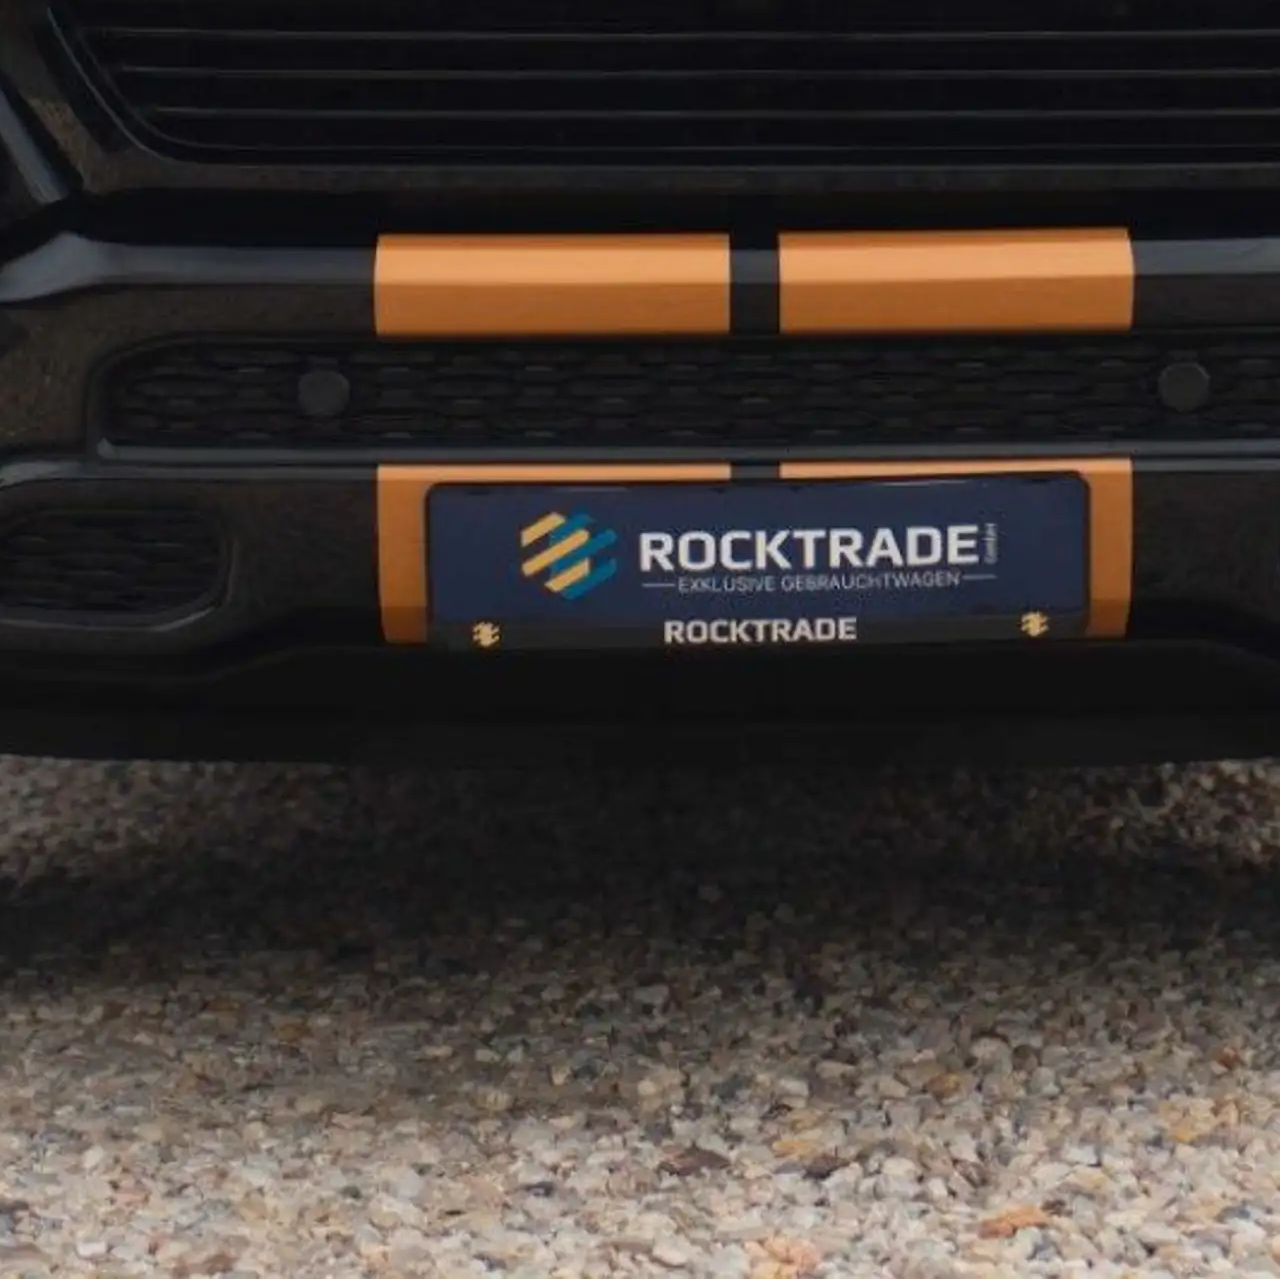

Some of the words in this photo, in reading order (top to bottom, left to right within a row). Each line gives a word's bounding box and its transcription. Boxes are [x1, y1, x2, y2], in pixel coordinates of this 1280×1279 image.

[640, 525, 980, 572] ROCKTRADE
[781, 571, 962, 592] GEBRAUCHTWAGEN
[664, 617, 857, 645] ROCKTRADE
